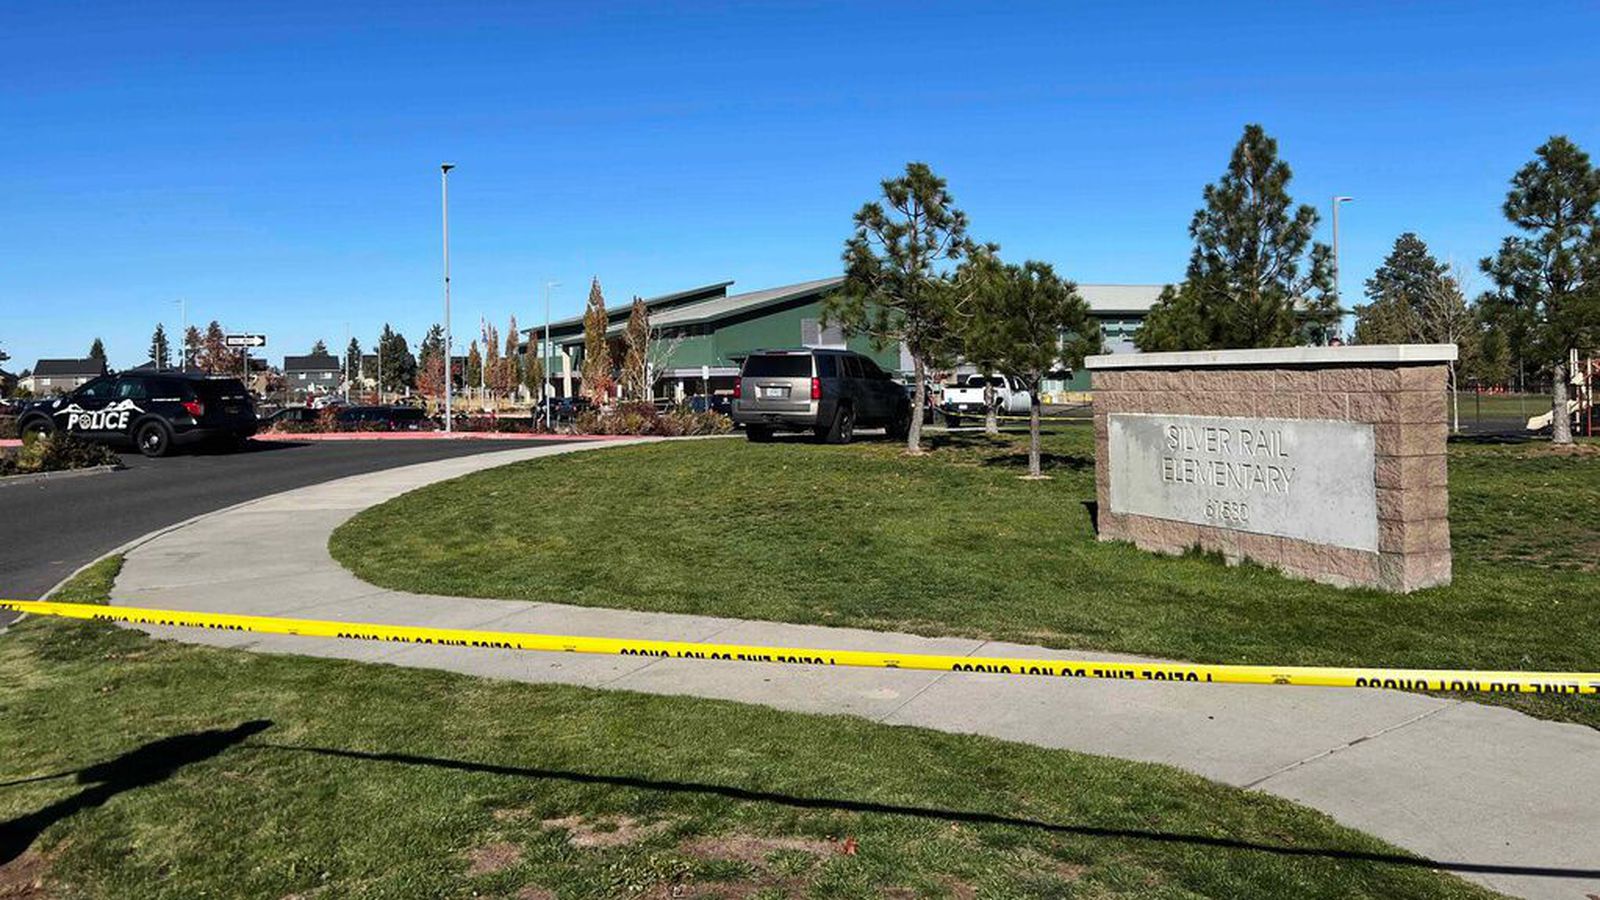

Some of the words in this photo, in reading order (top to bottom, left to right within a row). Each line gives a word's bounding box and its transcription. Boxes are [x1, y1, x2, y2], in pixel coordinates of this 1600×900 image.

[67, 411, 130, 430] POLICE
[1165, 424, 1231, 456] SILVER
[1240, 429, 1289, 457] RAIL
[1163, 457, 1296, 495] ELEMENTARY
